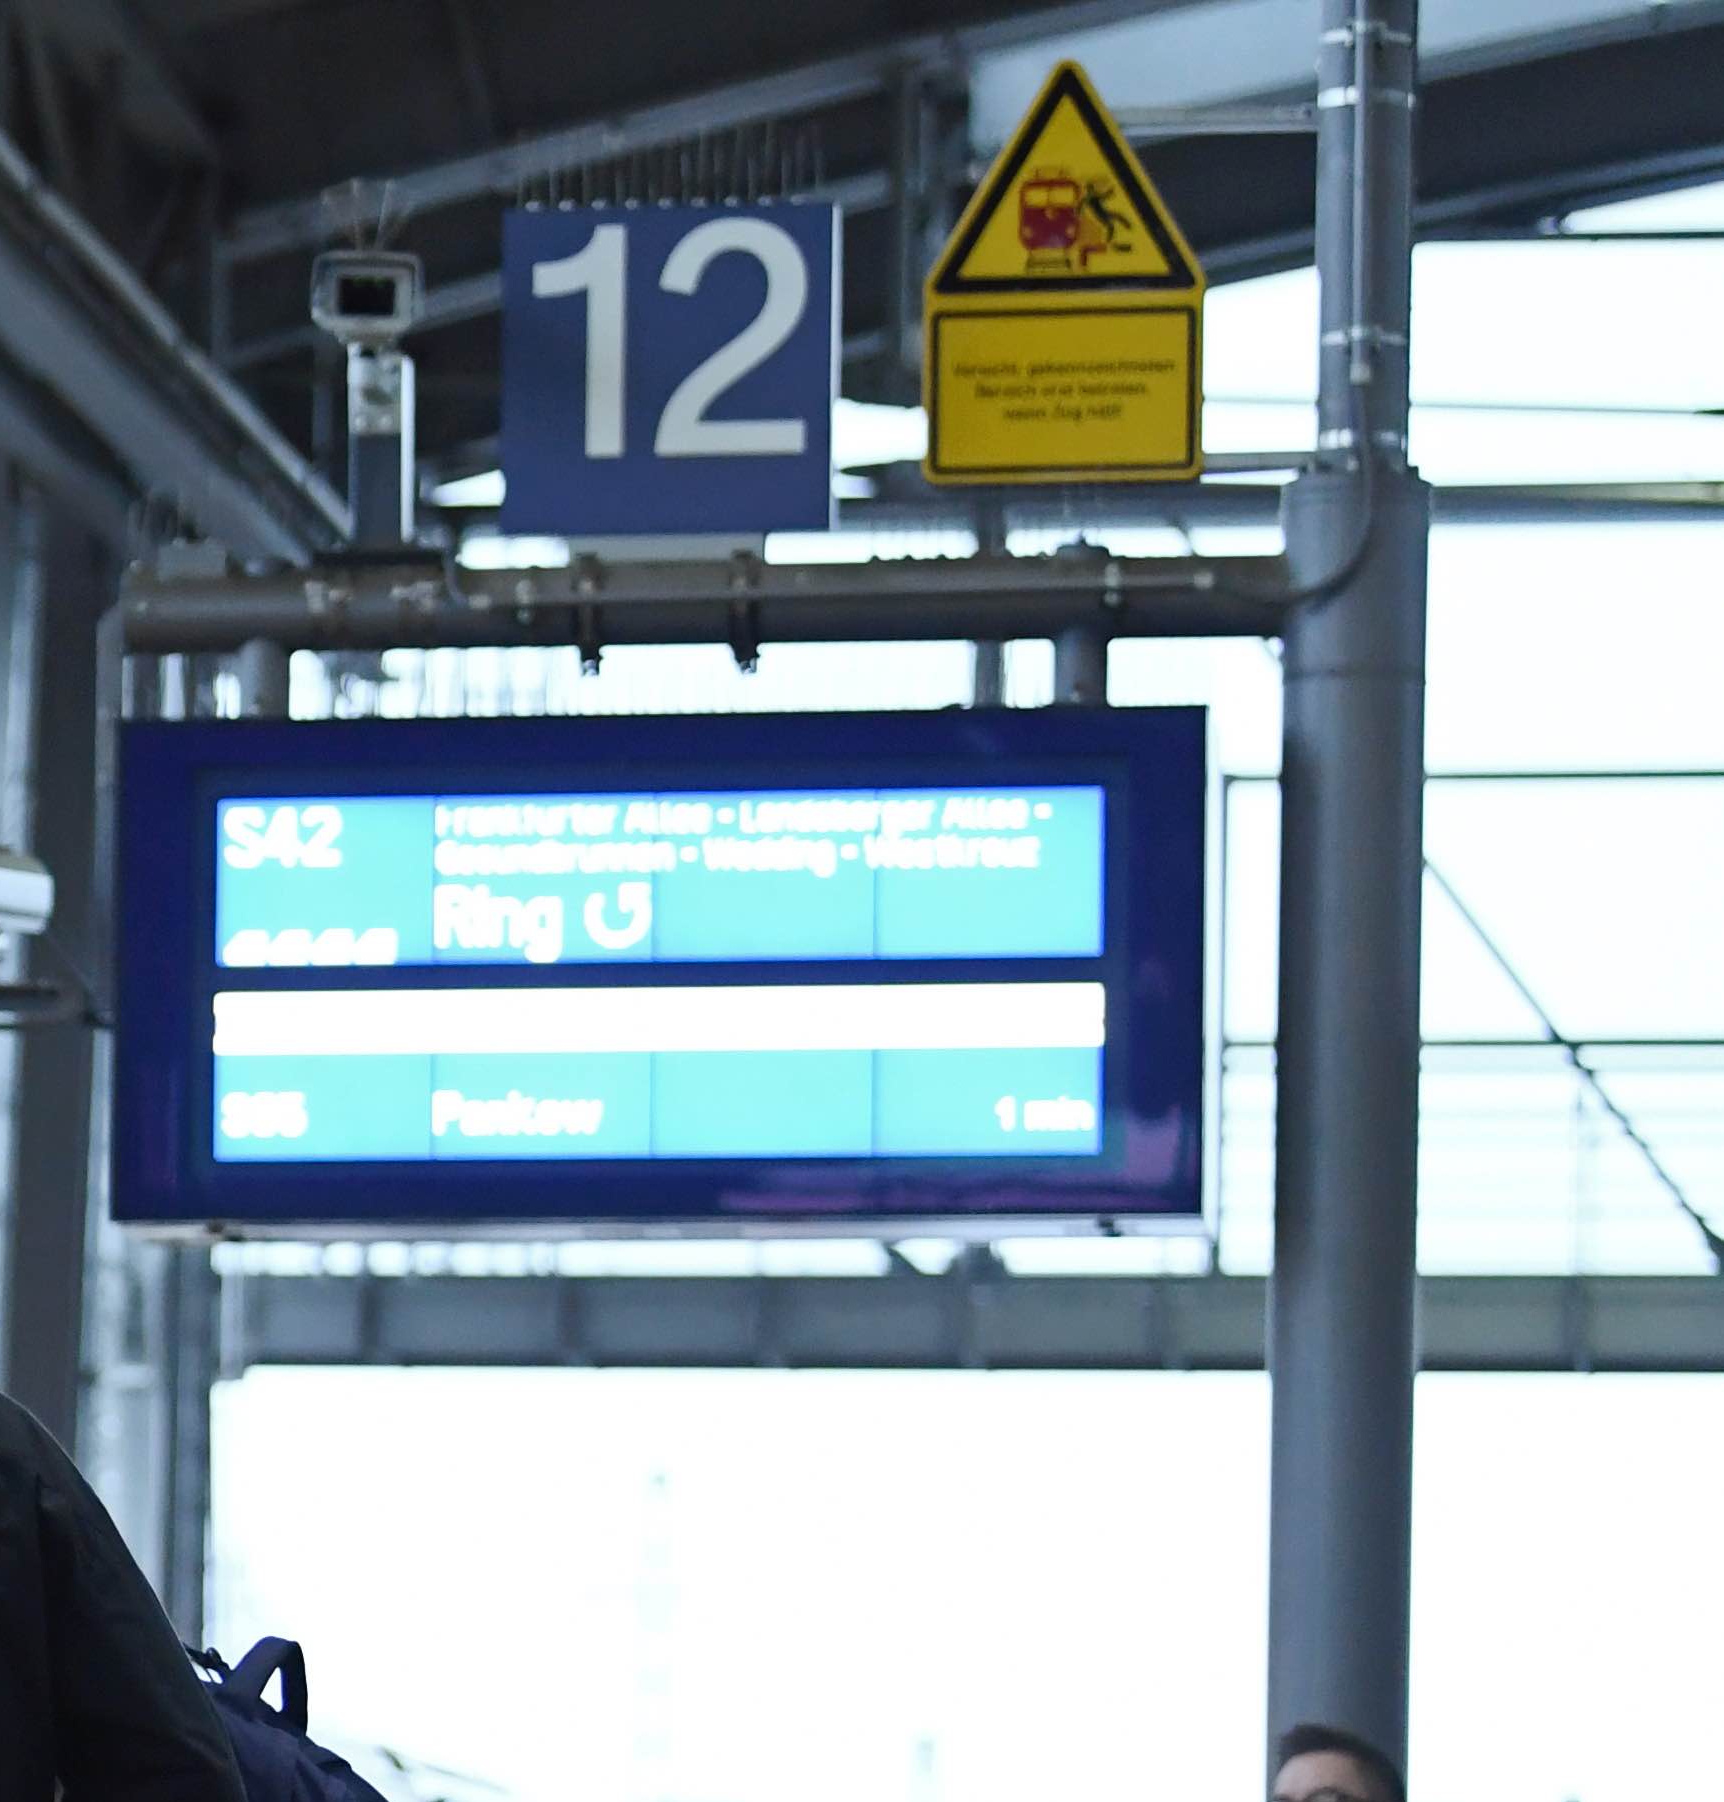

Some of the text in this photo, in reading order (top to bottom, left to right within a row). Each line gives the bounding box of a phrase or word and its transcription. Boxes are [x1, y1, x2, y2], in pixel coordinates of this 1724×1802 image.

[532, 217, 807, 458] 12
[223, 805, 343, 869] S42
[433, 883, 563, 963] Ring
